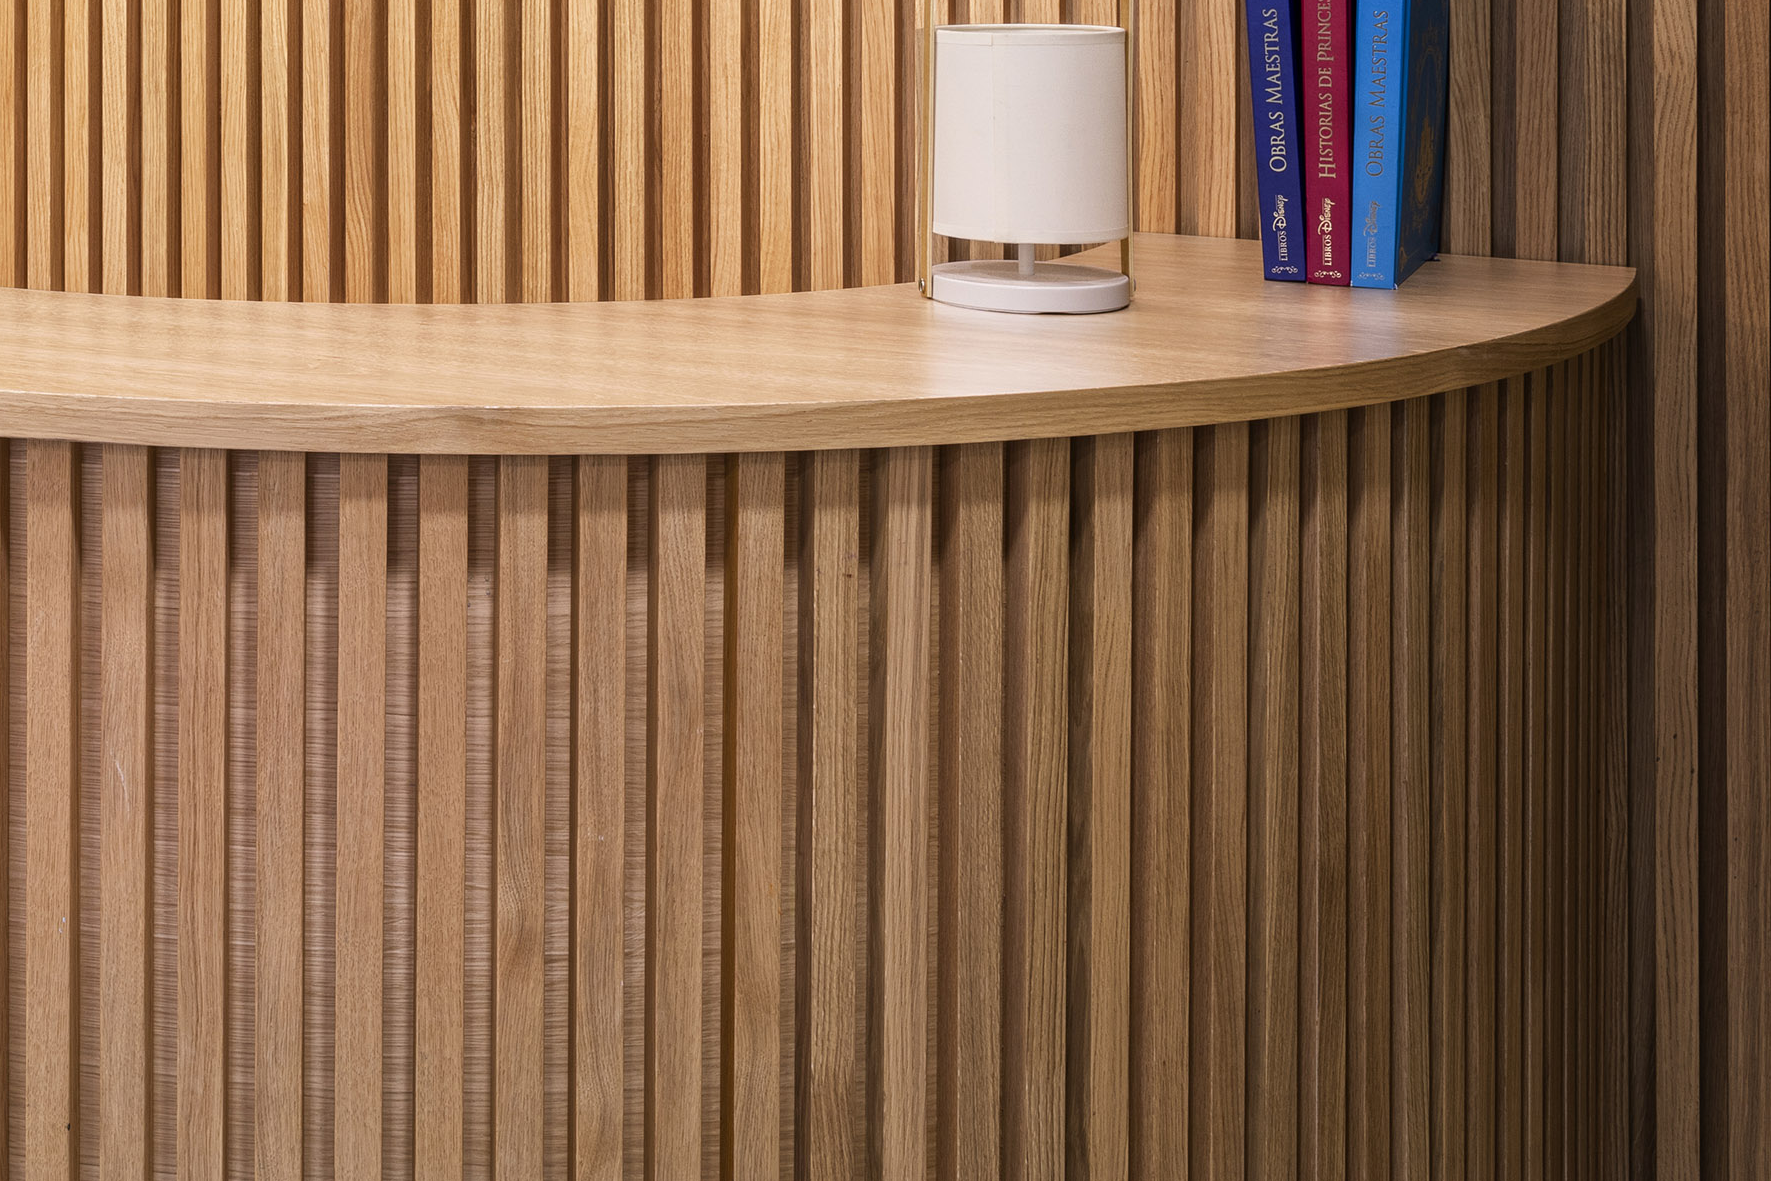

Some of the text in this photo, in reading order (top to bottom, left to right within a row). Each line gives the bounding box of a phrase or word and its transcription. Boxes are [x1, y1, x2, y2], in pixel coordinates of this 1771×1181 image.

[1262, 8, 1287, 172] OBRAS MAESTRAS
[1318, 67, 1332, 88] DE
[1366, 10, 1389, 177] OBRAS MAESTRAS
[1318, 93, 1336, 178] HISTORIAS
[1272, 195, 1289, 261] LIBROS Disney
[1318, 198, 1335, 266] LIBROS Disney
